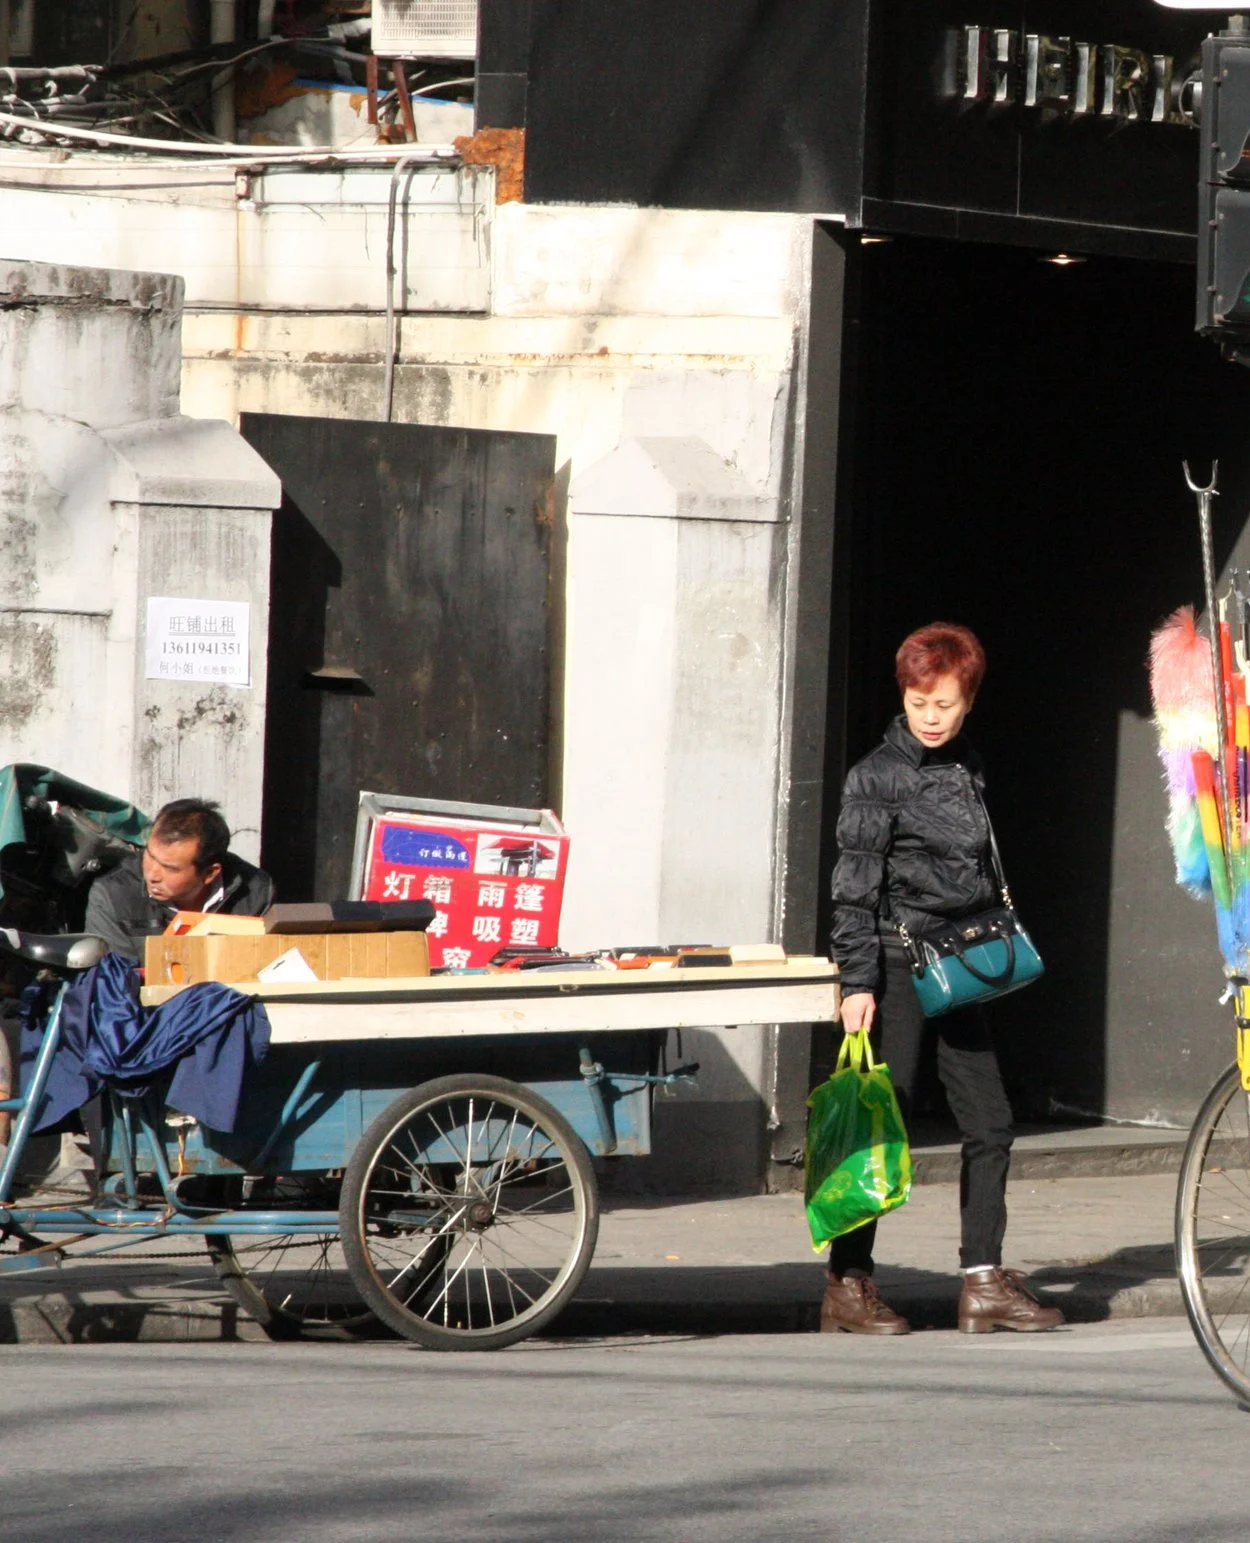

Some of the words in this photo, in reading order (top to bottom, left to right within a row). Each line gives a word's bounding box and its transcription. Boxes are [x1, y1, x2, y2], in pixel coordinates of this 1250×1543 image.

[168, 615, 236, 634] 旺铺出租
[162, 641, 241, 655] 13611941351
[383, 870, 454, 905] 灯箱
[477, 879, 545, 912] 雨篷
[472, 916, 540, 945] 吸塑
